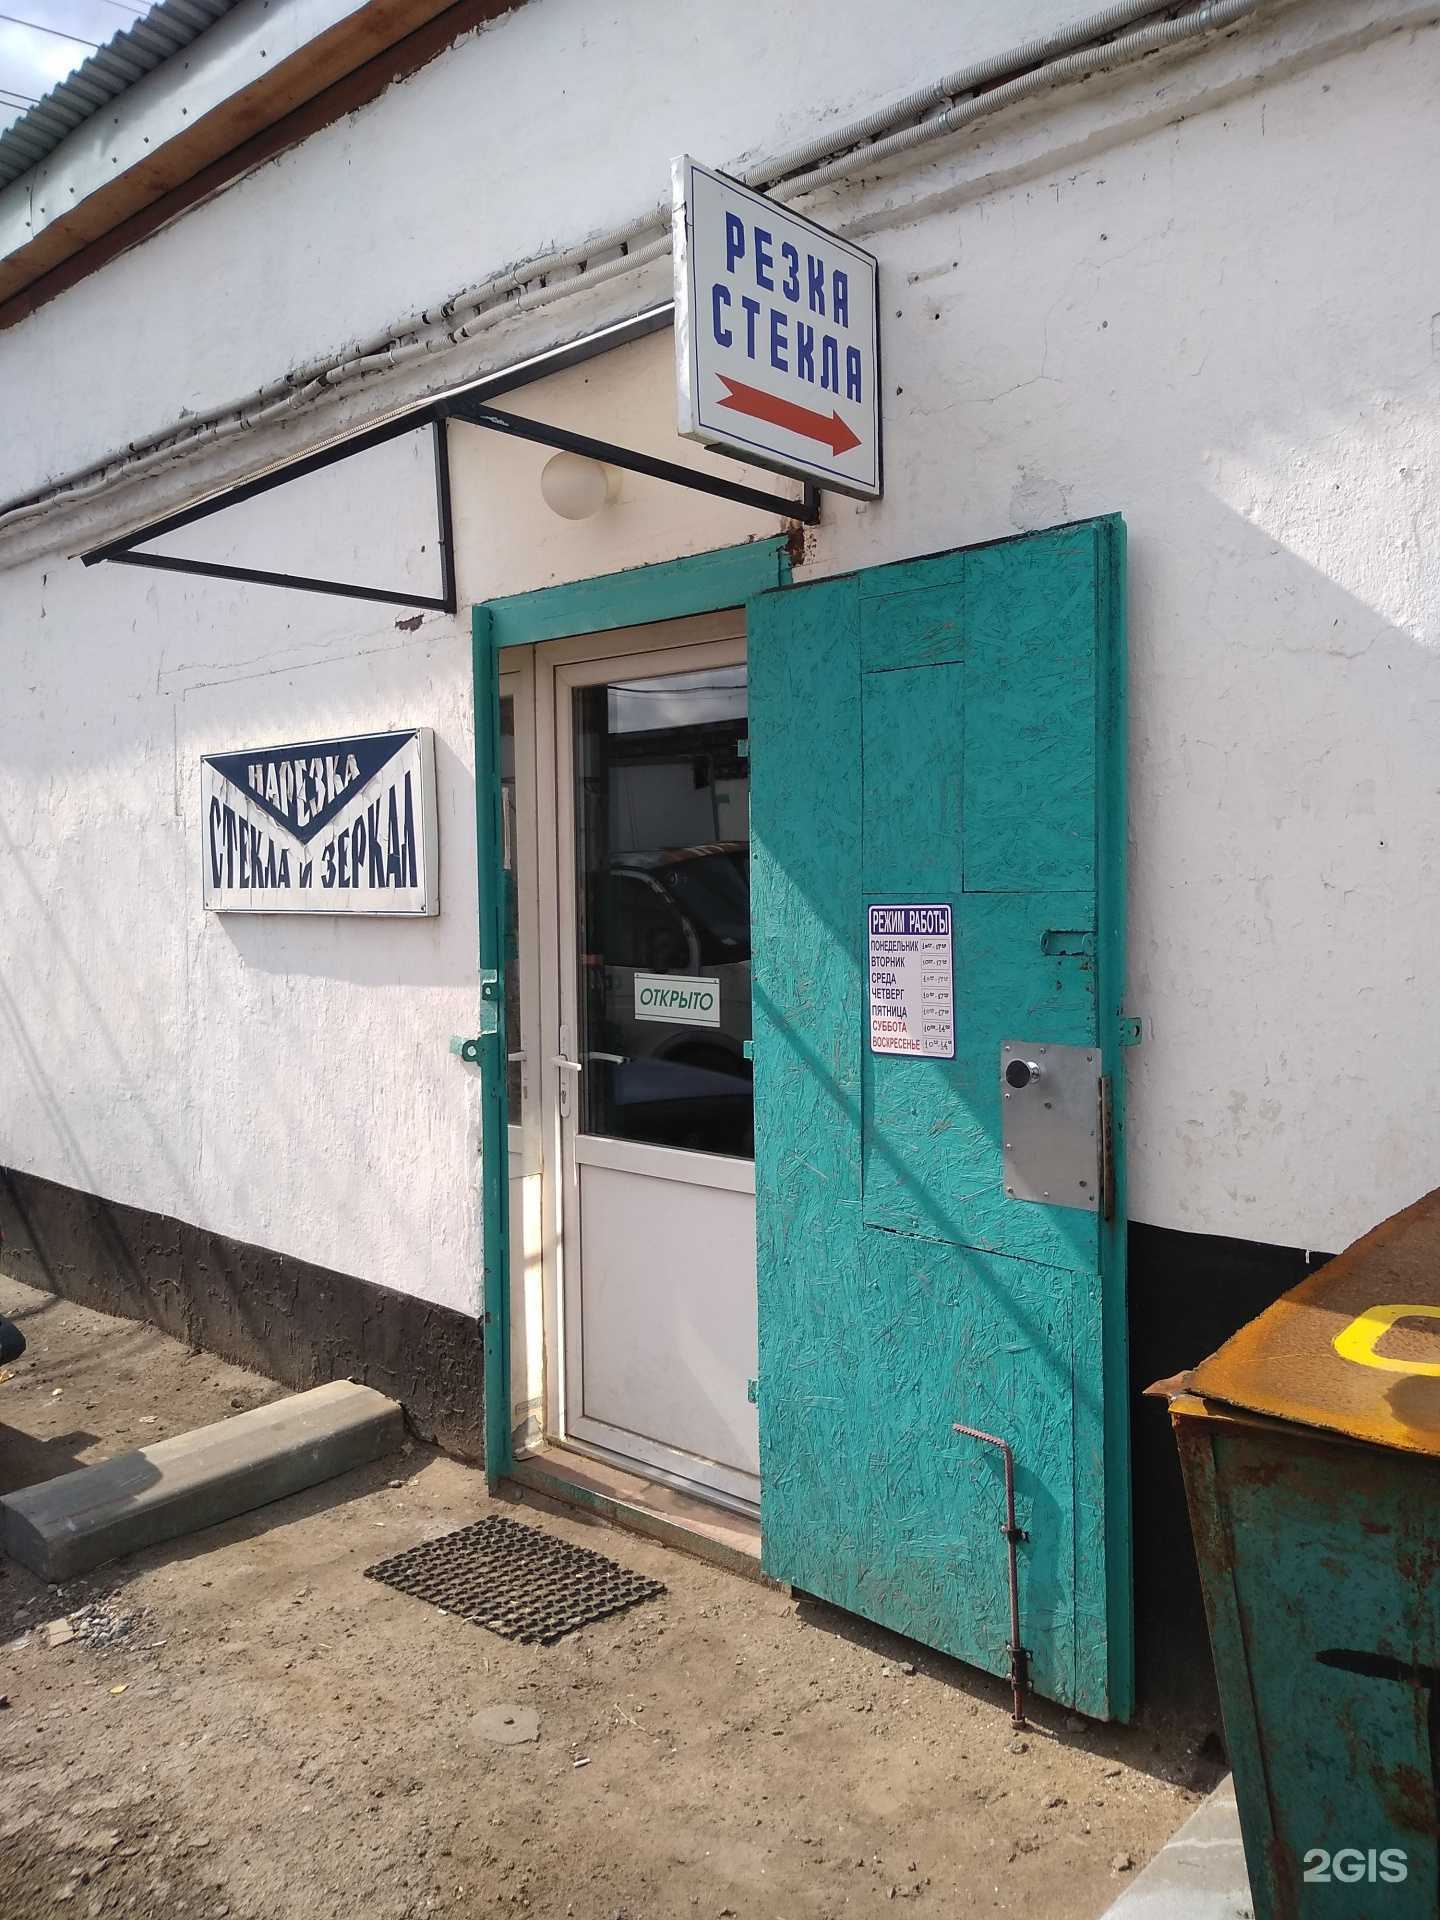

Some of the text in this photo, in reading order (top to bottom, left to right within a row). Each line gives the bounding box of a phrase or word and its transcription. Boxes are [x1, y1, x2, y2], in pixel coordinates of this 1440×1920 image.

[725, 211, 848, 328] РЕЗКА
[712, 283, 861, 403] СТЕКЛА
[248, 754, 360, 827] НАРЕЗКА
[209, 795, 291, 888] СТЕКЛА
[321, 770, 418, 888] ЗЕРКАЛ
[873, 910, 948, 933] РЕЖИМ РАБОТЫ
[871, 940, 919, 953] ПОНЕДЕЛЬНИК
[871, 956, 905, 967] ВТОРНИК
[871, 973, 897, 985] СРЕДА
[640, 988, 714, 1011] ОТКРЫТО
[872, 988, 904, 1000] ЧЕТВЕРГ
[872, 1005, 907, 1019] ПЯТНИЦА
[873, 1020, 907, 1033] СУББОТА
[873, 1036, 920, 1050] ВОСКРЕСЕНЬЕ
